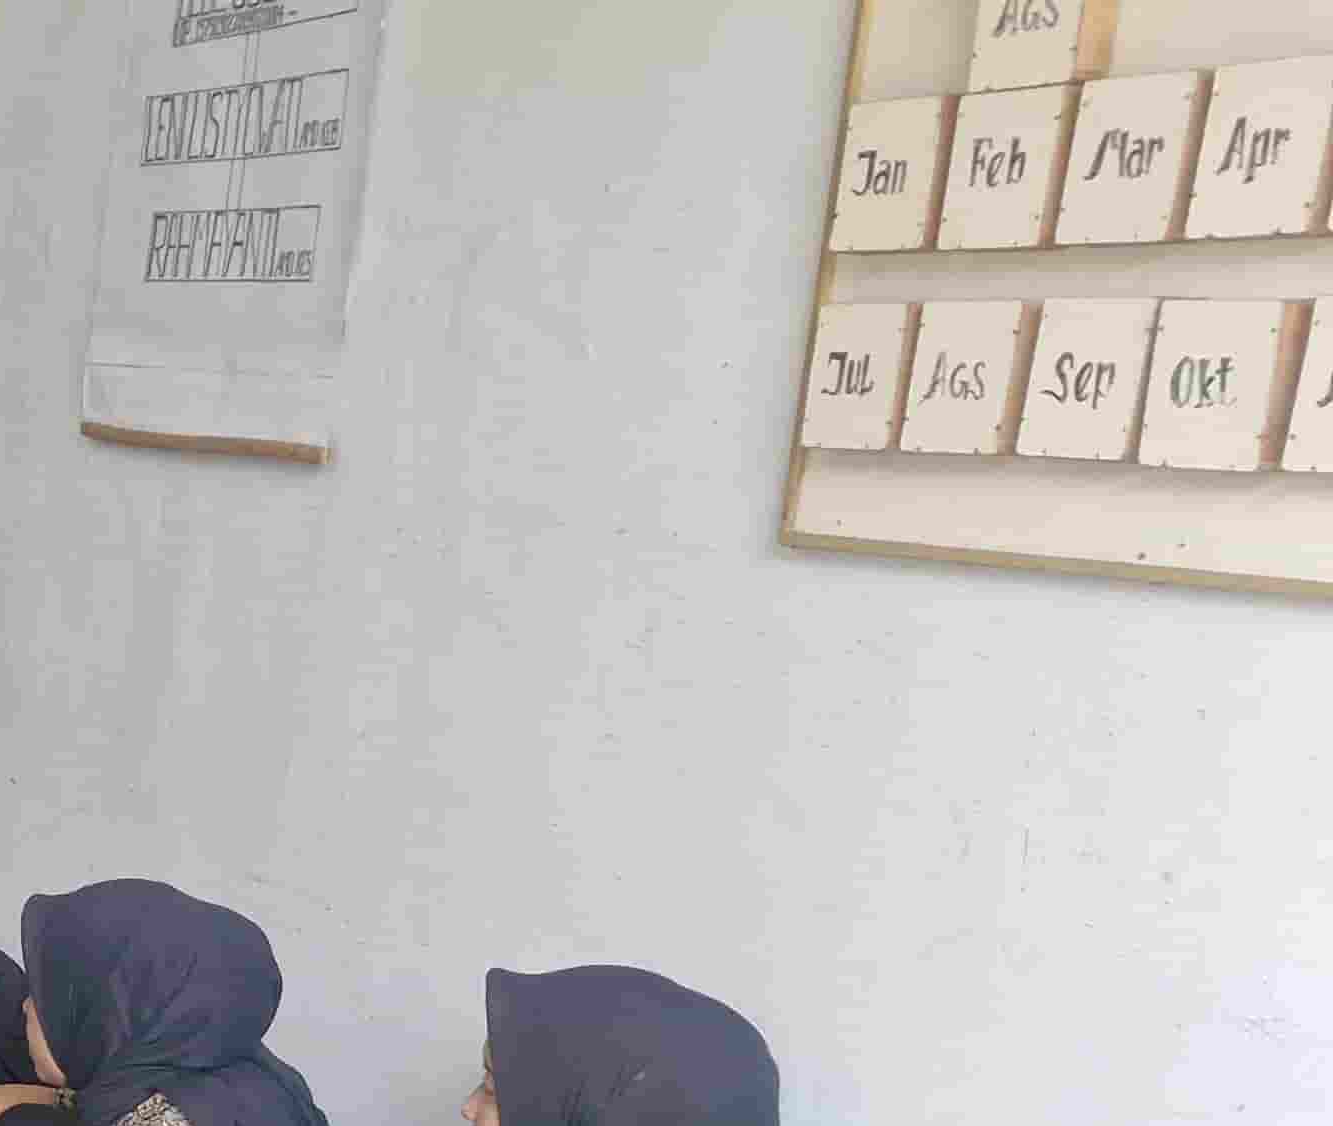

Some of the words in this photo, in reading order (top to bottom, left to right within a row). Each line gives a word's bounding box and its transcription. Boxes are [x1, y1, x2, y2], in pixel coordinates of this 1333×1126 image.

[852, 149, 908, 196] Jan
[969, 136, 1027, 187] Feb
[1084, 128, 1166, 181] Mar
[1214, 116, 1291, 184] Apr
[917, 351, 986, 405] AGS
[1038, 351, 1116, 409] Sep
[1170, 355, 1236, 408] Okt
